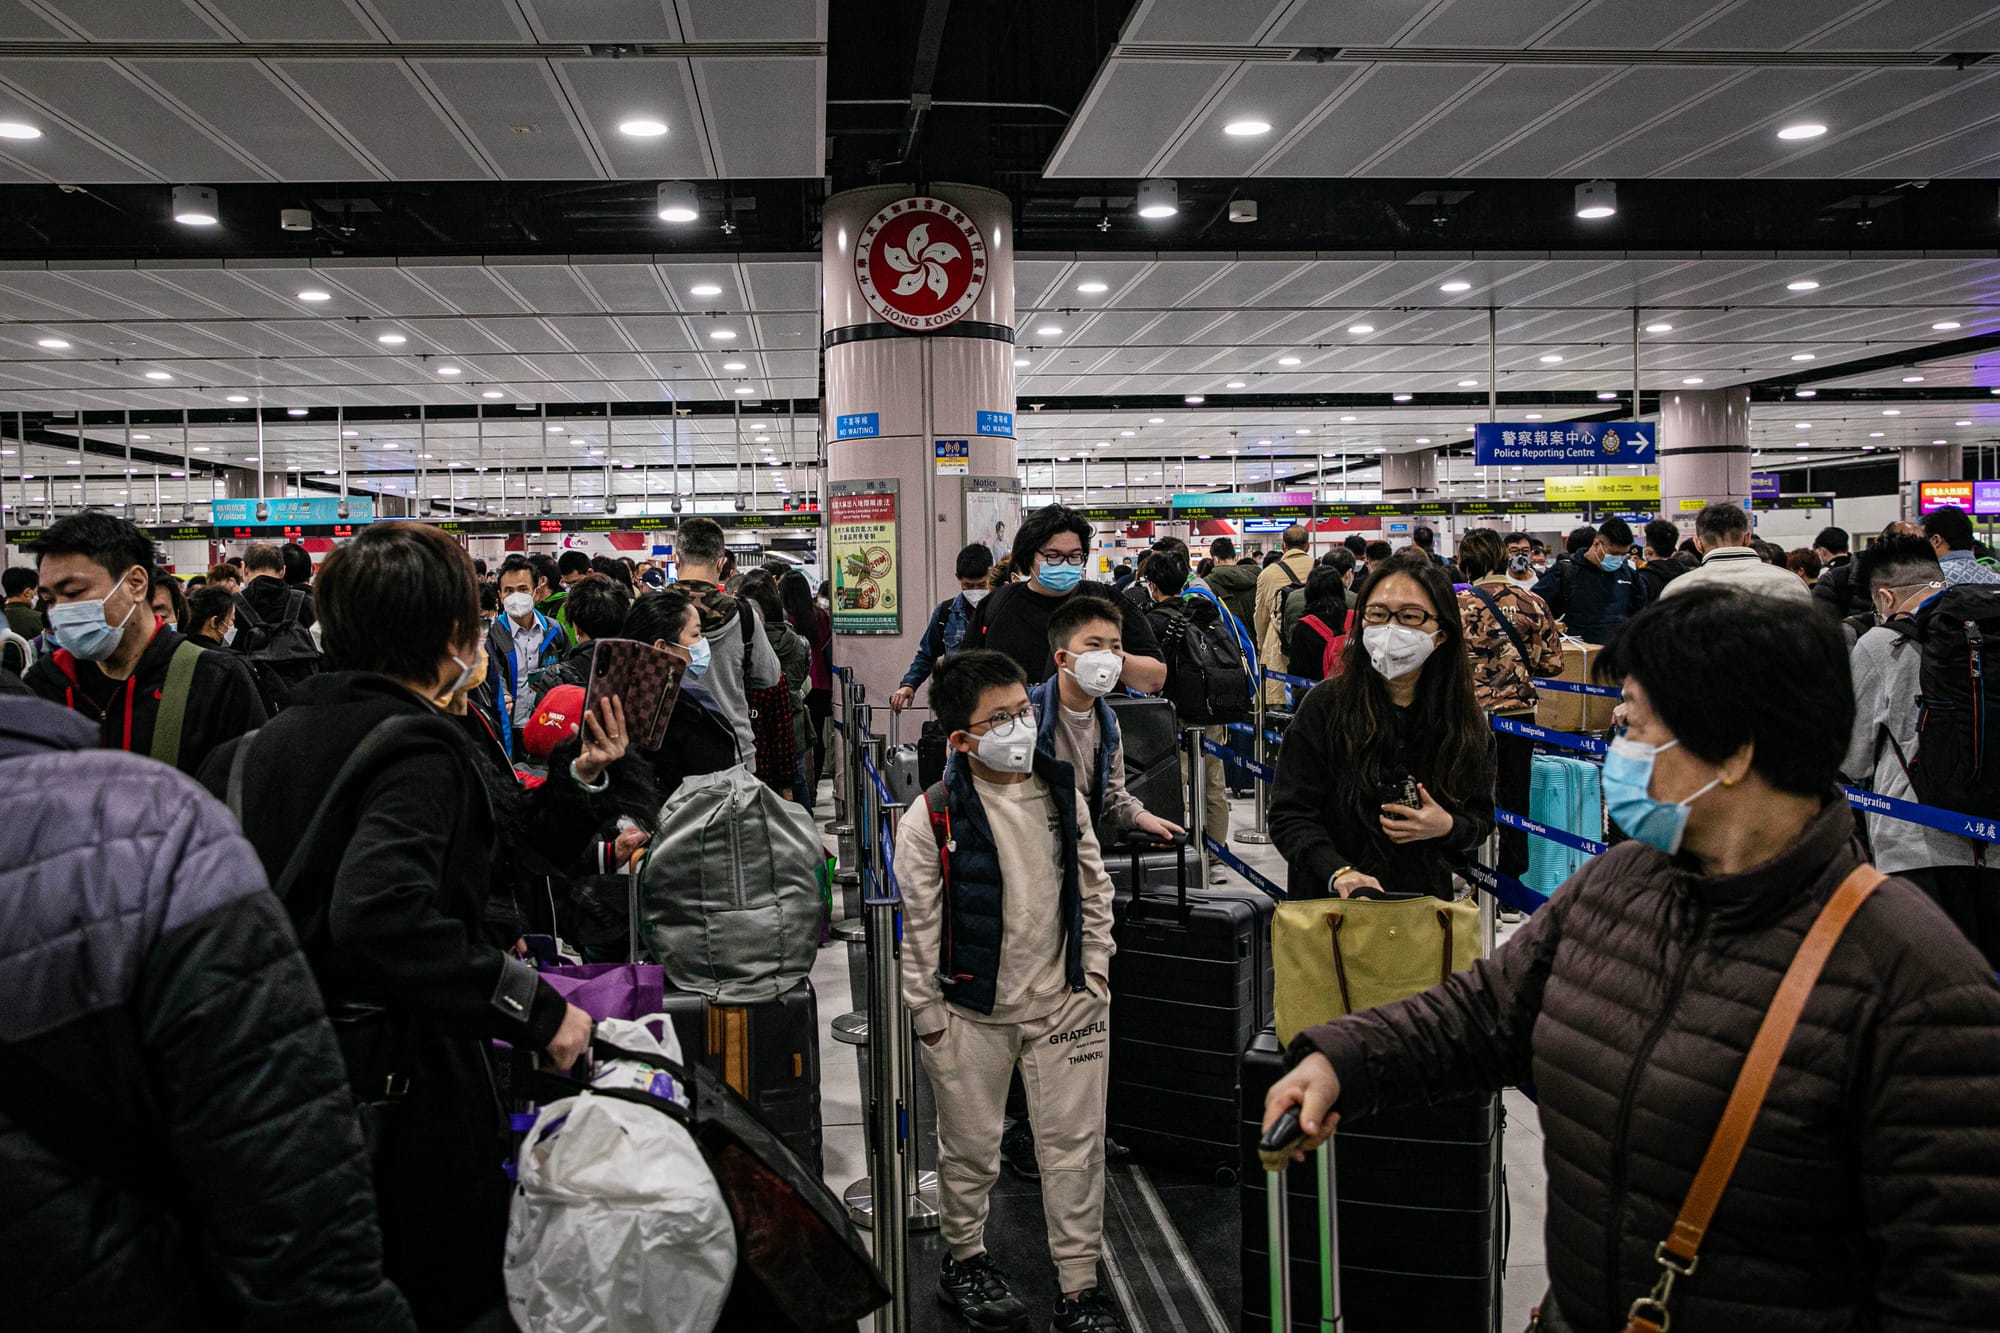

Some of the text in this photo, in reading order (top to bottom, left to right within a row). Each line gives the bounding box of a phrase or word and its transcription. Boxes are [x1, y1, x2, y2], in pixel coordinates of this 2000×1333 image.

[882, 305, 962, 326] HONG KONG
[1502, 430, 1596, 446] 警察報案中心
[1494, 448, 1595, 459] Police Reporting Centre
[974, 479, 997, 487] Notice
[1521, 725, 1545, 737] Immigration
[1845, 790, 1891, 810] Immigration
[1522, 819, 1546, 834] Immigration
[1964, 821, 1996, 839] 入境處
[1049, 1020, 1106, 1044] GRATEFUL
